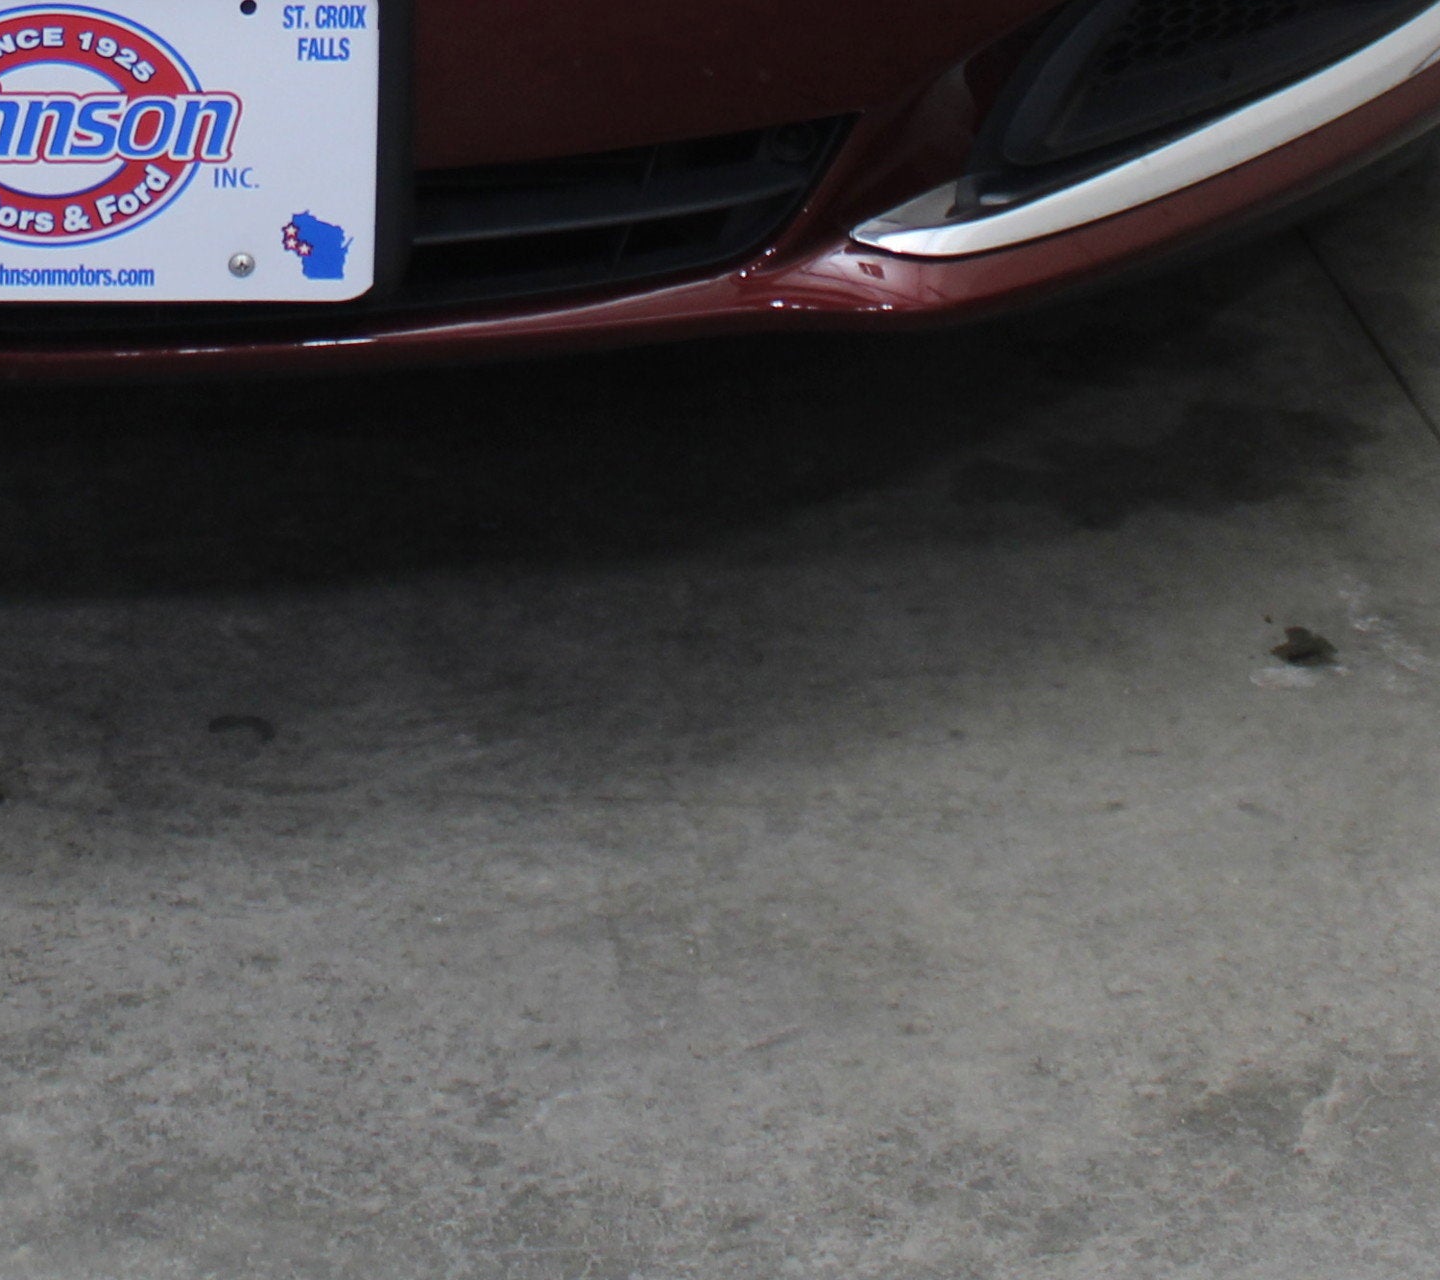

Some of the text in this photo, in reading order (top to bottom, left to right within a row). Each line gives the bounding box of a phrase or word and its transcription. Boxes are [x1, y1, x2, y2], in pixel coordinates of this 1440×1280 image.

[282, 4, 367, 29] ST. CROIX
[77, 31, 156, 84] 1925
[297, 37, 351, 62] FALLS
[213, 168, 261, 189] INC.
[63, 206, 91, 233] &
[97, 164, 171, 225] Ford
